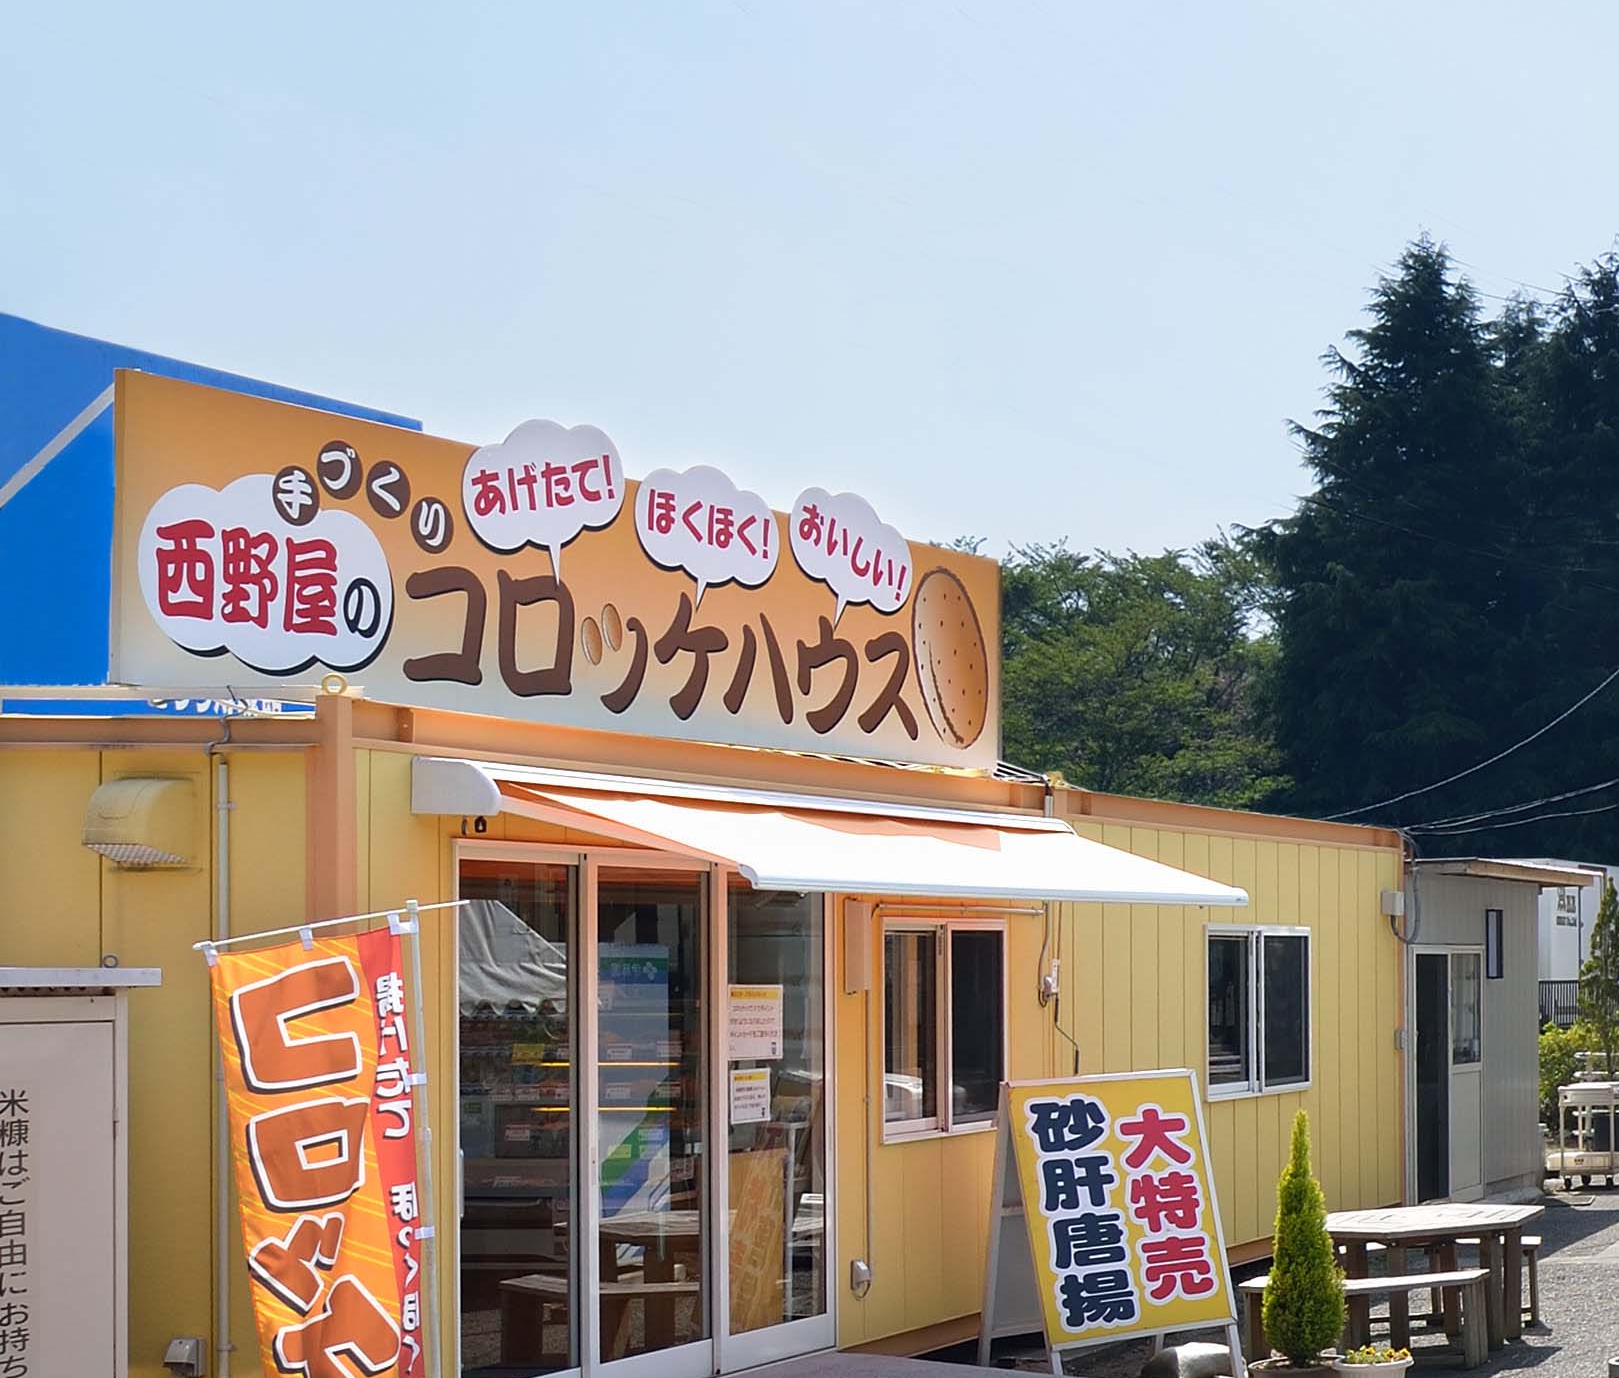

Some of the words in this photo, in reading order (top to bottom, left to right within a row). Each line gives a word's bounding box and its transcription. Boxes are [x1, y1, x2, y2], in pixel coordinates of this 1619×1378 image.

[276, 442, 452, 549] 手づくり
[471, 452, 615, 520] あげたて!
[646, 486, 770, 559] ほくほく!
[154, 518, 382, 639] 西野屋の
[798, 502, 911, 603] おいしい!
[404, 566, 919, 742] コロッケハウス
[1029, 1098, 1137, 1327] 砂肝唐揚
[1120, 1108, 1214, 1300] 大特売
